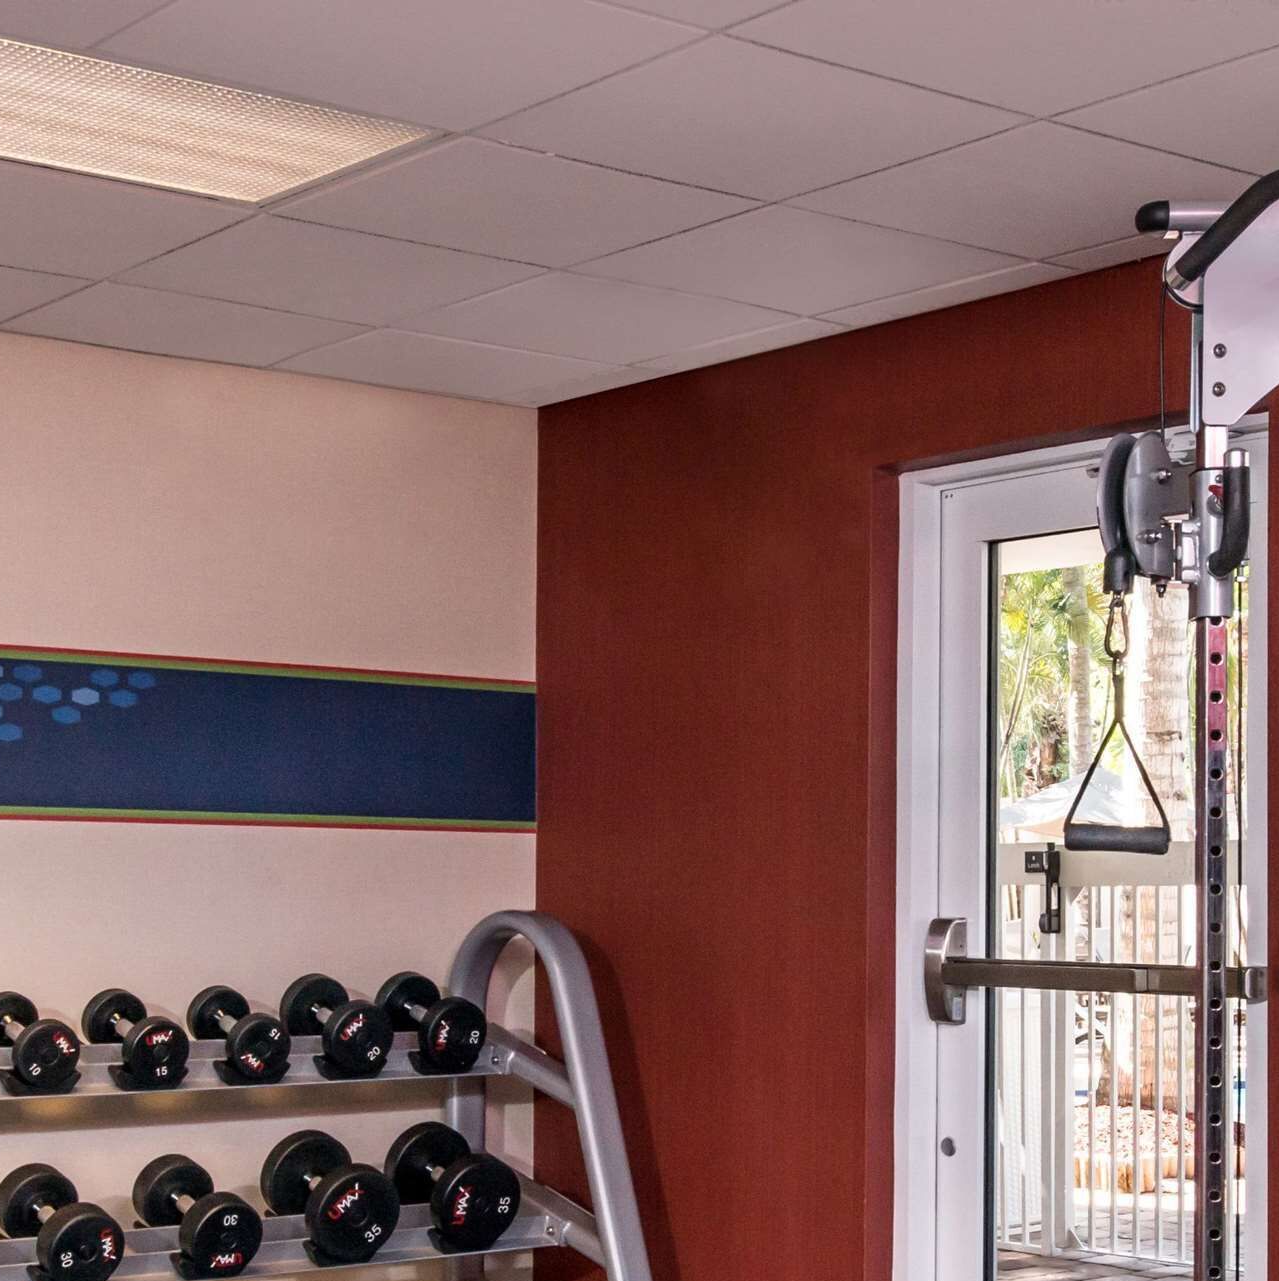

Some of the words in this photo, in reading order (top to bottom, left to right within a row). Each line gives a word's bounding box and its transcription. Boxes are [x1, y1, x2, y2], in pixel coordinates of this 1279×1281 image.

[269, 1028, 281, 1041] 15
[470, 1030, 481, 1044] 20
[367, 1046, 381, 1061] 20
[28, 1063, 41, 1076] 10
[155, 1066, 168, 1077] 15
[327, 1182, 365, 1222] UMAX
[451, 1186, 476, 1225] UMAX
[498, 1196, 511, 1214] 35
[223, 1214, 239, 1226] 30
[364, 1223, 382, 1243] 35
[100, 1227, 116, 1262] UMAX
[61, 1252, 73, 1268] 30
[210, 1252, 244, 1268] UMAX
